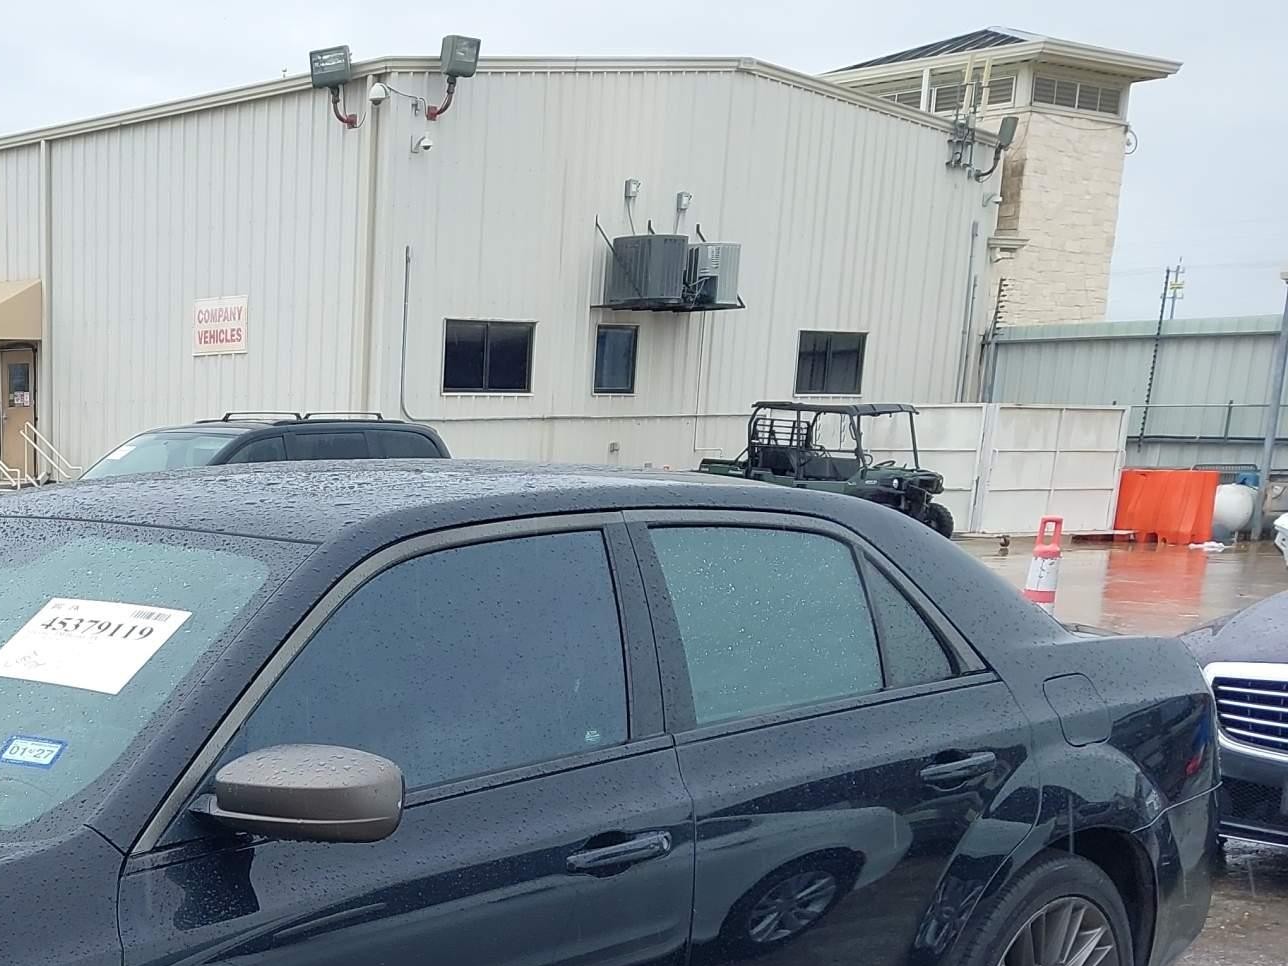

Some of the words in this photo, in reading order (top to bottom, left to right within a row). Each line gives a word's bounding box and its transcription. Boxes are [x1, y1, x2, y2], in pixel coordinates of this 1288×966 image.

[197, 305, 243, 324] COMPANY
[197, 327, 242, 345] VEHICLES
[40, 616, 155, 640] 45379119
